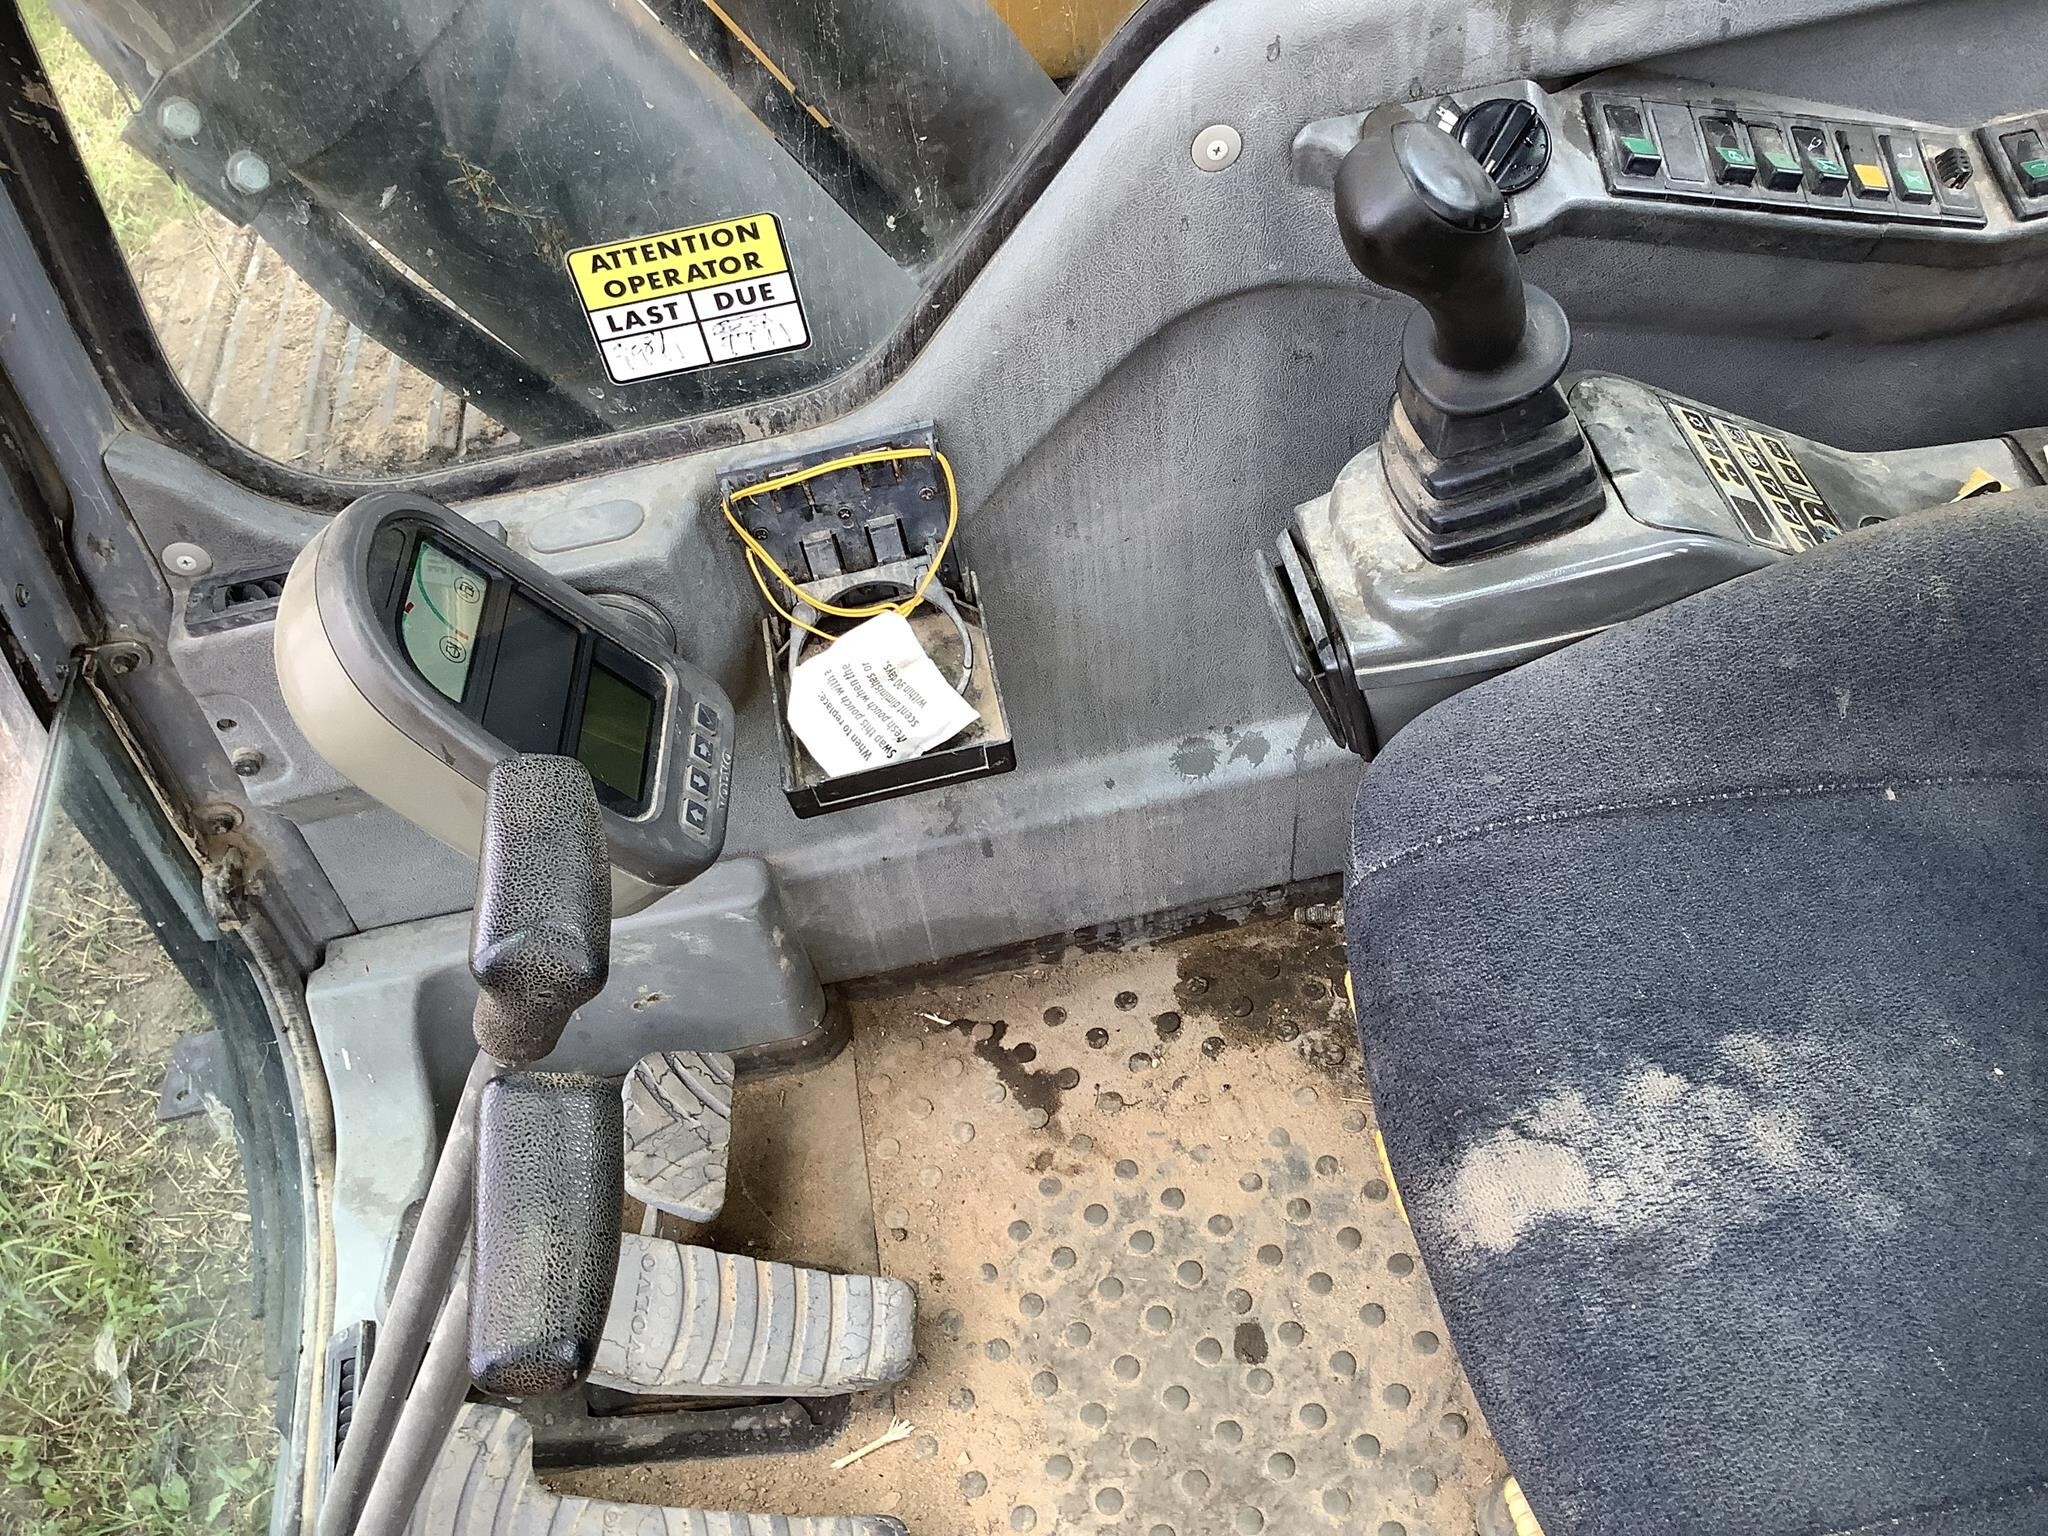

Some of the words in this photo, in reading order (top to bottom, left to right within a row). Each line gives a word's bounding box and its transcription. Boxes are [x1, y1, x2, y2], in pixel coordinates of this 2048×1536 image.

[591, 222, 760, 273] ATTENTION
[604, 251, 763, 298] OPERATOR
[714, 283, 775, 310] DUE
[606, 302, 678, 333] LAST
[842, 663, 855, 680] the
[862, 662, 872, 671] or
[883, 661, 898, 681] days.
[828, 675, 844, 695] with
[850, 679, 870, 702] when
[867, 673, 901, 712] diminishes
[893, 679, 906, 689] 90
[841, 695, 865, 720] pouch
[904, 685, 927, 708] within
[818, 692, 844, 725] replace:
[867, 702, 892, 722] pouch
[901, 705, 919, 727] scent
[843, 724, 852, 736] to
[860, 719, 876, 737] this
[851, 734, 872, 761] When
[874, 734, 896, 758] Swap
[717, 752, 732, 810] VOLVO
[627, 1252, 656, 1355] VOLVO
